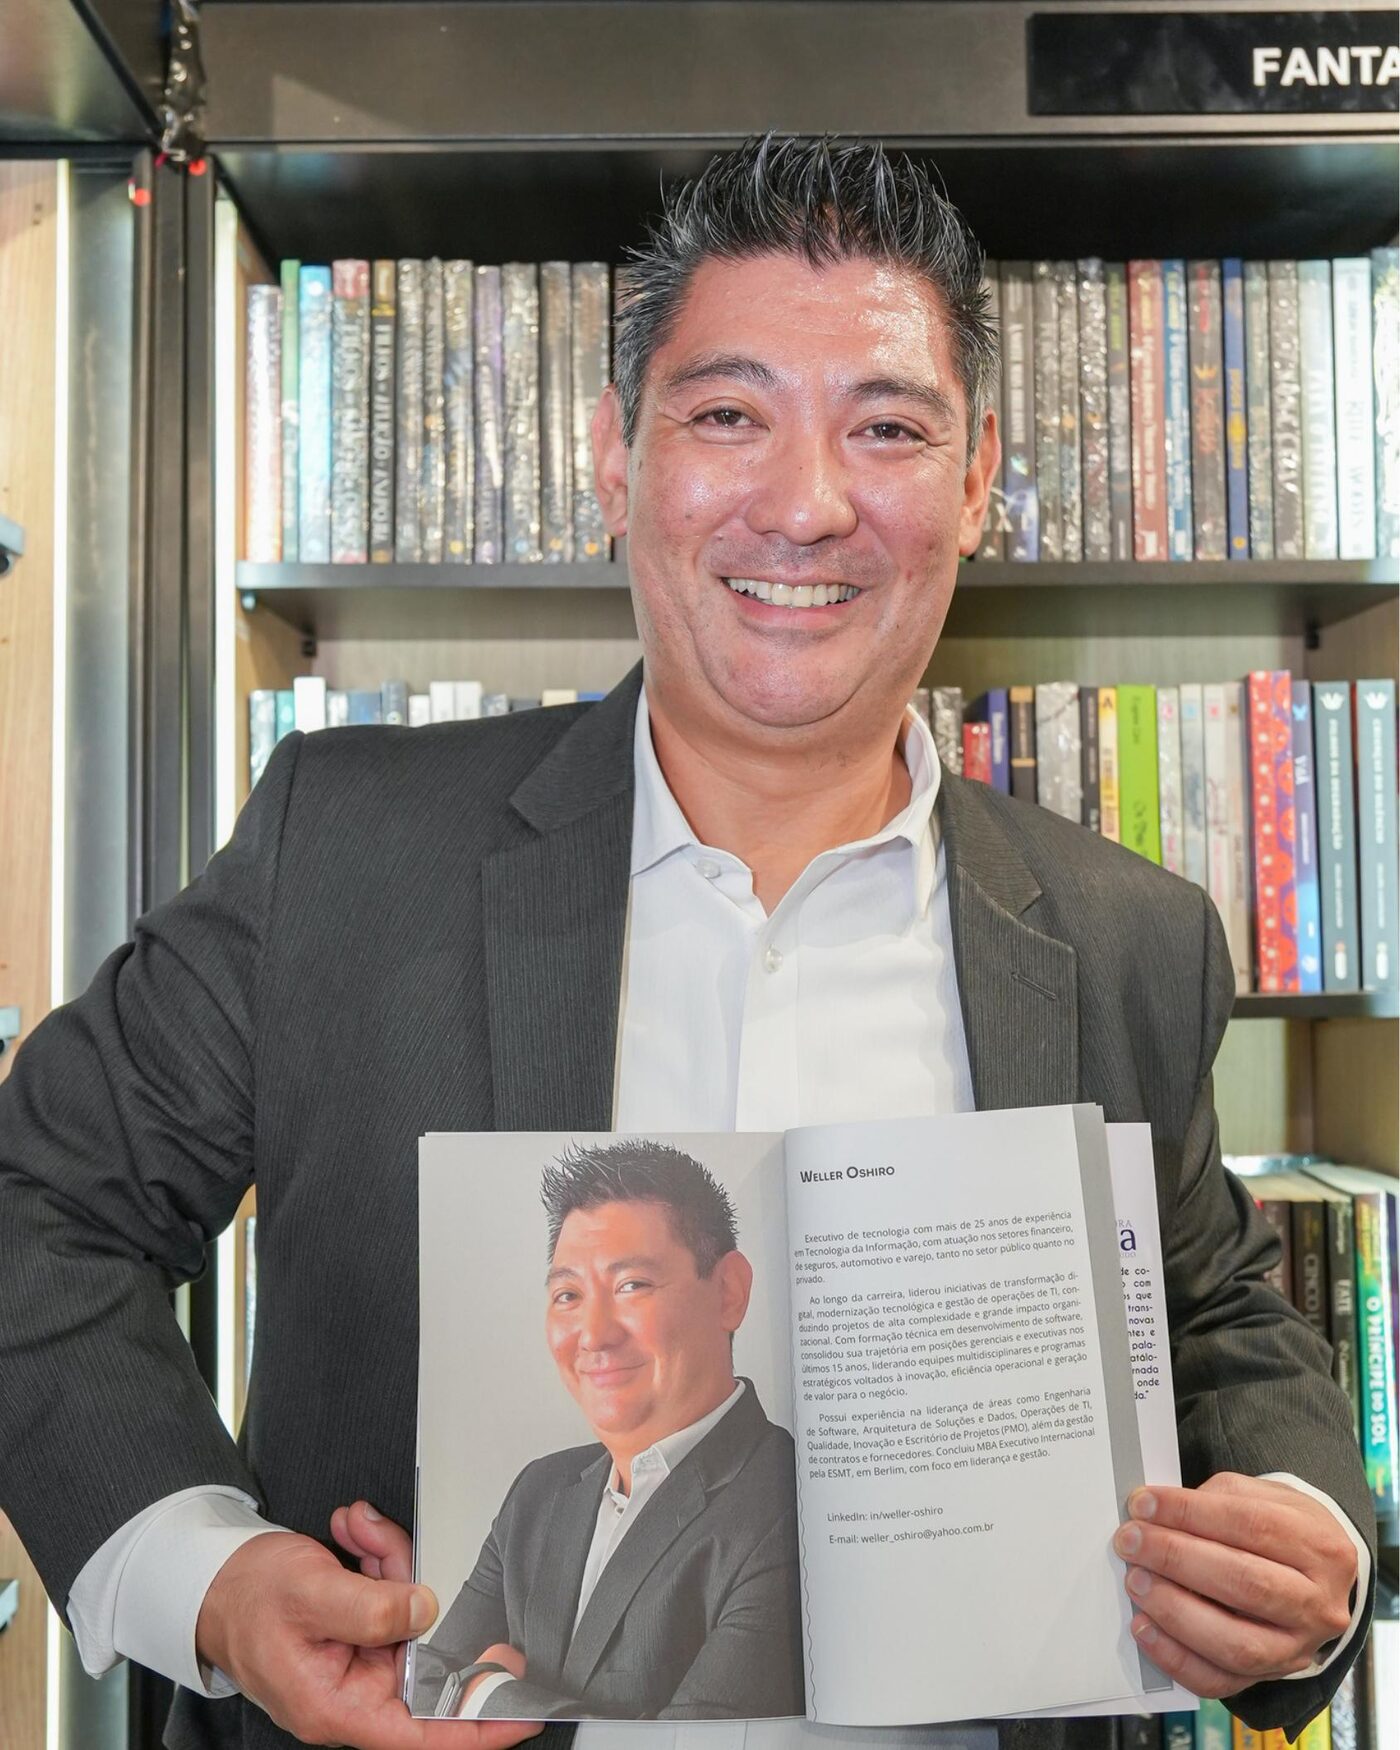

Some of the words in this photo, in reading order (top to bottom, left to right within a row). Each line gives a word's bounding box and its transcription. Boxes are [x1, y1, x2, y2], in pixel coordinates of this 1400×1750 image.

[1253, 47, 1399, 85] FANTA
[805, 1246, 850, 1257] Tecnologia
[851, 1244, 864, 1253] da
[865, 1240, 921, 1252] Informação,
[922, 1239, 942, 1247] com
[944, 1234, 979, 1245] atuação
[980, 1233, 996, 1241] nos
[998, 1230, 1029, 1240] setores
[1030, 1225, 1073, 1236] financeiro,
[847, 1231, 859, 1240] de
[862, 1228, 910, 1239] tecnologia
[913, 1226, 933, 1234] com
[936, 1223, 957, 1232] mais
[959, 1221, 971, 1230] de
[974, 1219, 986, 1228] 25
[988, 1218, 1009, 1227] anos
[1011, 1216, 1022, 1225] de
[1025, 1211, 1072, 1224] experiência
[804, 1262, 838, 1272] seguros,
[840, 1256, 894, 1268] automotivo
[903, 1253, 934, 1263] varejo,
[936, 1250, 960, 1260] tanto
[975, 1247, 998, 1256] setor
[1000, 1242, 1031, 1254] público
[1032, 1240, 1062, 1251] quanto
[1064, 1238, 1075, 1246] no
[816, 1306, 880, 1318] modernização
[882, 1302, 935, 1314] tecnológica
[945, 1297, 975, 1310] gestão
[977, 1295, 988, 1304] de
[990, 1291, 1035, 1304] operações
[1037, 1289, 1048, 1298] de
[1062, 1286, 1080, 1295] con-
[823, 1295, 848, 1306] longo
[851, 1293, 863, 1302] da
[866, 1290, 905, 1301] carreira,
[908, 1288, 941, 1297] liderou
[944, 1282, 987, 1294] iniciativas
[989, 1280, 1001, 1289] de
[1004, 1273, 1065, 1288] transformação
[1136, 1292, 1152, 1300] que
[1366, 1296, 1381, 1312] O
[832, 1322, 870, 1333] projetos
[872, 1319, 885, 1328] de
[888, 1318, 906, 1327] alta
[908, 1311, 971, 1325] complexidade
[982, 1306, 1014, 1320] grande
[1016, 1303, 1050, 1314] impacto
[1052, 1300, 1081, 1311] organi-
[834, 1336, 856, 1345] Com
[858, 1332, 903, 1343] formação
[905, 1329, 938, 1340] técnica
[940, 1328, 954, 1336] em
[956, 1319, 1030, 1334] desenvolvimento
[1032, 1317, 1043, 1326] de
[1045, 1313, 1083, 1324] software,
[845, 1364, 870, 1372] anos,
[872, 1358, 917, 1370] liderando
[918, 1355, 955, 1367] equipes
[956, 1347, 1032, 1361] multidisciplinares
[1041, 1340, 1086, 1354] programas
[846, 1350, 863, 1358] sua
[865, 1345, 909, 1358] trajetória
[911, 1344, 926, 1353] em
[928, 1340, 968, 1353] posições
[970, 1334, 1014, 1349] gerenciais
[1023, 1328, 1067, 1340] executivas
[1069, 1326, 1085, 1334] nos
[1131, 1341, 1156, 1350] pala-
[1367, 1314, 1385, 1390] PRÍNCIPE
[854, 1375, 894, 1385] voltados
[905, 1369, 948, 1381] inovação,
[951, 1365, 992, 1377] eficiência
[994, 1357, 1044, 1373] operacional
[1054, 1352, 1088, 1367] geração
[1136, 1378, 1160, 1387] onde
[814, 1392, 834, 1401] valor
[837, 1392, 858, 1402] para
[868, 1388, 908, 1400] negócio.
[819, 1413, 847, 1422] Possui
[851, 1409, 906, 1423] experiência
[926, 1404, 968, 1415] liderança
[988, 1398, 1013, 1408] áreas
[1016, 1395, 1040, 1405] como
[1044, 1388, 1091, 1402] Engenharia
[818, 1427, 859, 1437] Software,
[863, 1423, 917, 1436] Arquitetura
[935, 1416, 976, 1428] Soluções
[987, 1411, 1017, 1422] Dados,
[1020, 1405, 1066, 1419] Operações
[853, 1438, 896, 1450] Inovação
[905, 1433, 948, 1445] Escritório
[963, 1428, 1000, 1440] Projetos
[1031, 1421, 1053, 1430] além
[1066, 1414, 1094, 1428] gestão
[1370, 1413, 1387, 1445] SOL
[819, 1456, 861, 1464] contratos
[869, 1450, 934, 1462] fornecedores.
[936, 1444, 975, 1456] Concluiu
[976, 1441, 998, 1451] MBA
[999, 1437, 1039, 1449] Executivo
[1040, 1427, 1095, 1442] Internacional
[827, 1468, 854, 1478] ESMT,
[874, 1466, 907, 1476] Berlim,
[909, 1464, 930, 1473] com
[931, 1461, 952, 1471] foco
[970, 1455, 1011, 1466] liderança
[1019, 1448, 1050, 1462] gestão.
[827, 1512, 868, 1522] LinkedIn:
[870, 1506, 944, 1520] in/weller-oshiro
[829, 1534, 859, 1544] E-mail:
